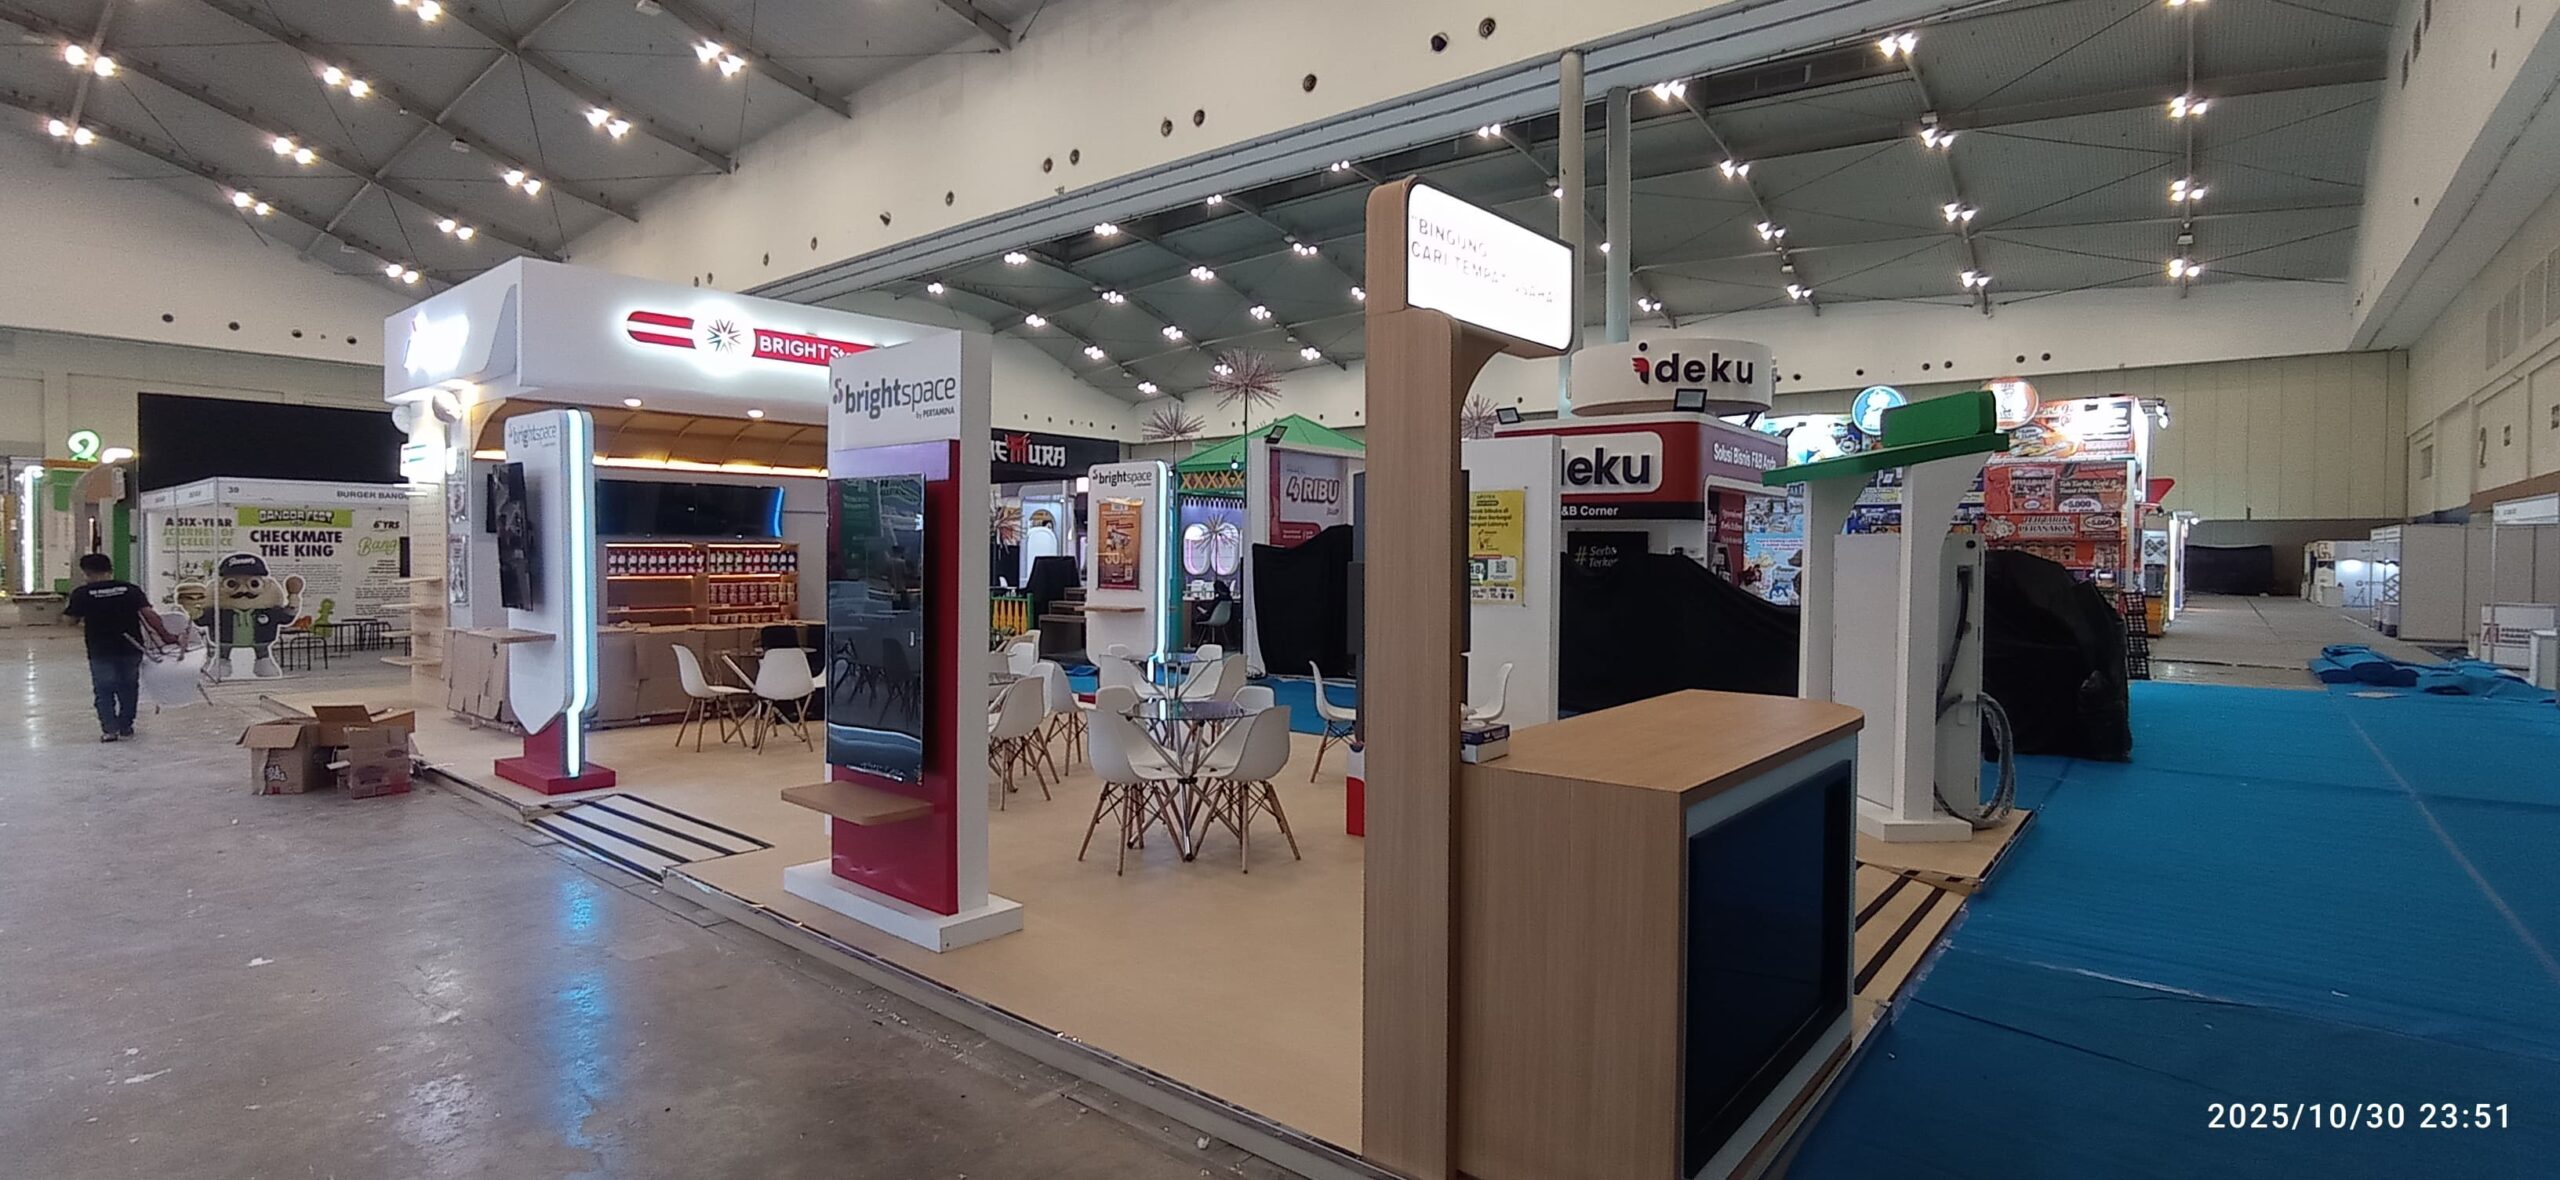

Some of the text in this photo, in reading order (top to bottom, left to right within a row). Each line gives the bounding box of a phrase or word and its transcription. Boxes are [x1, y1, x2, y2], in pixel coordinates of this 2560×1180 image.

[1411, 241, 1447, 265] CARI
[759, 335, 828, 361] BRIGHT
[1632, 342, 1753, 385] ideku
[845, 376, 956, 419] brightspace
[923, 406, 955, 419] PERTAMINA
[512, 424, 557, 448] brightspace
[1713, 443, 1733, 464] Solusi
[1734, 448, 1751, 468] Bisnis
[1751, 452, 1763, 469] F&B
[1561, 447, 1650, 486] eku
[1099, 470, 1153, 486] brightspace
[228, 486, 239, 494] 39
[336, 490, 376, 499] BURGER
[1286, 476, 1340, 504] 4 RIBU
[1580, 505, 1619, 516] Corner
[165, 517, 174, 527] A
[250, 530, 343, 543] CHECKMATE
[260, 544, 334, 557] THE KING
